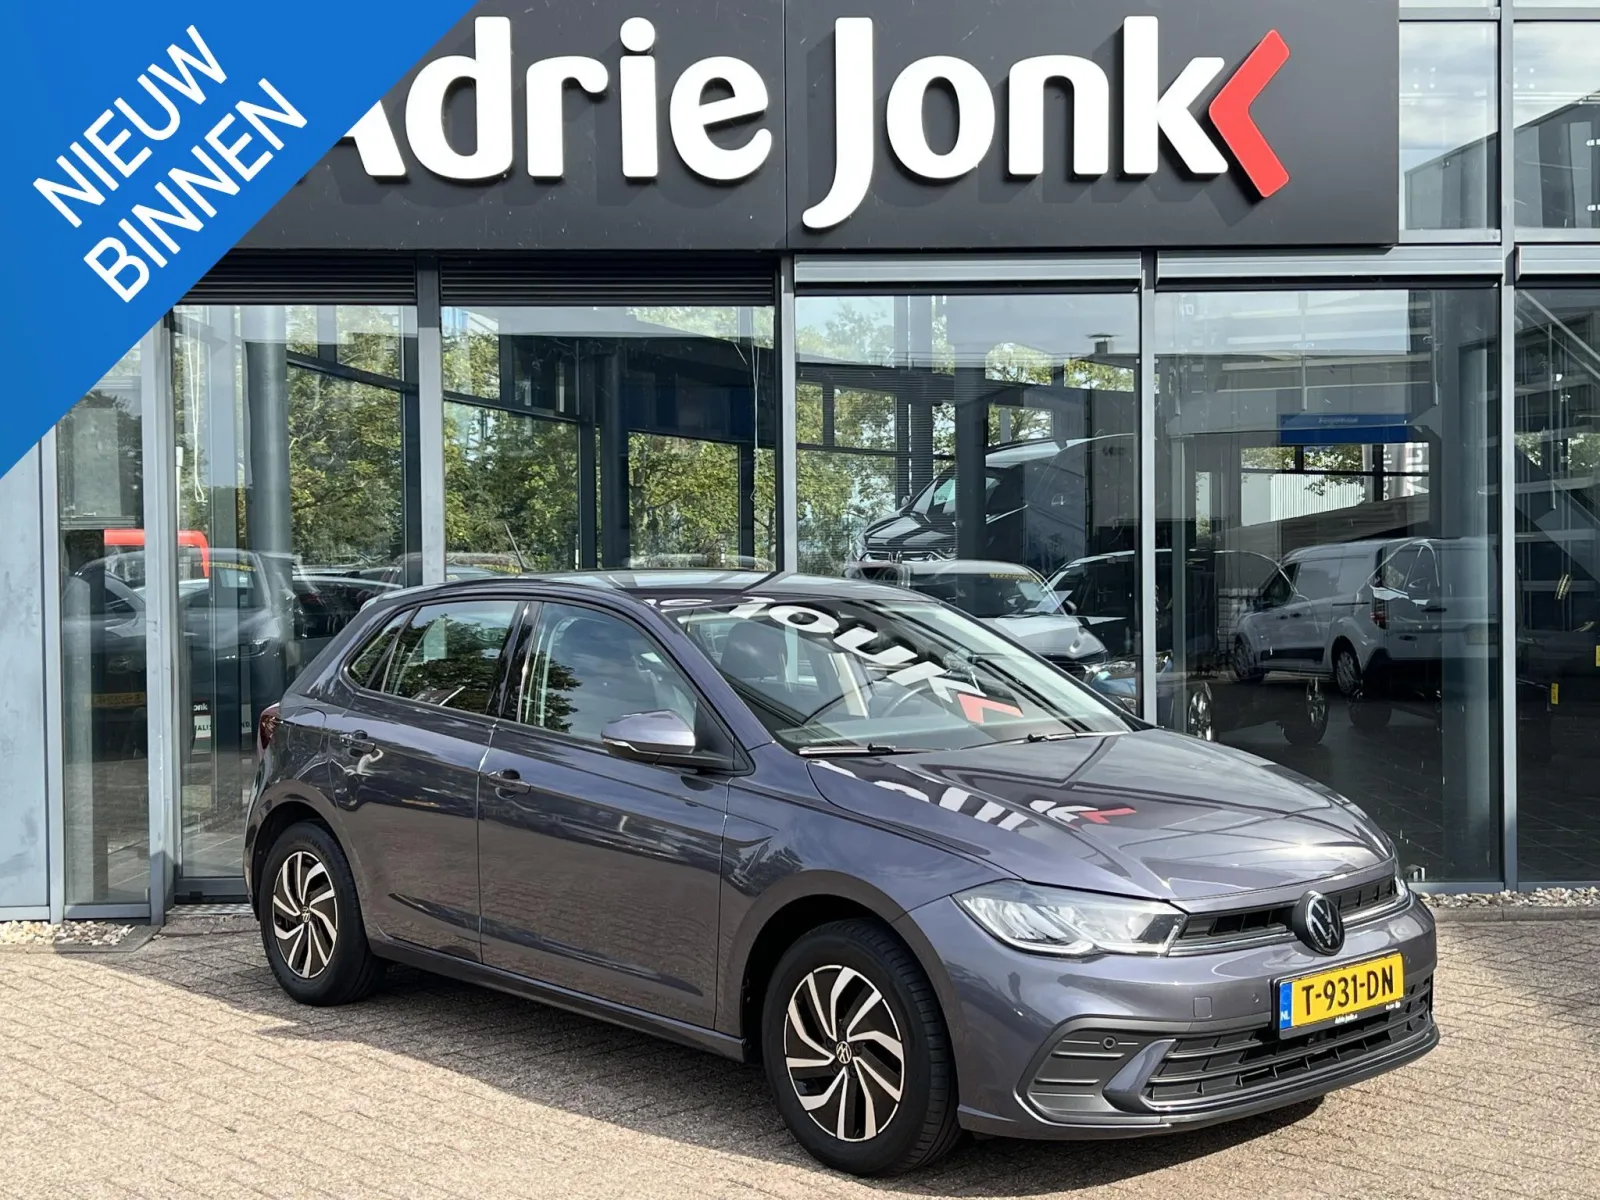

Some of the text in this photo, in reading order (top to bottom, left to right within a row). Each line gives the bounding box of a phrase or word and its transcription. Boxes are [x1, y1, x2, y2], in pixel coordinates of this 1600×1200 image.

[802, 15, 1229, 229] Jonk
[1280, 1010, 1291, 1021] NL
[1302, 965, 1394, 1016] T-931-DN
